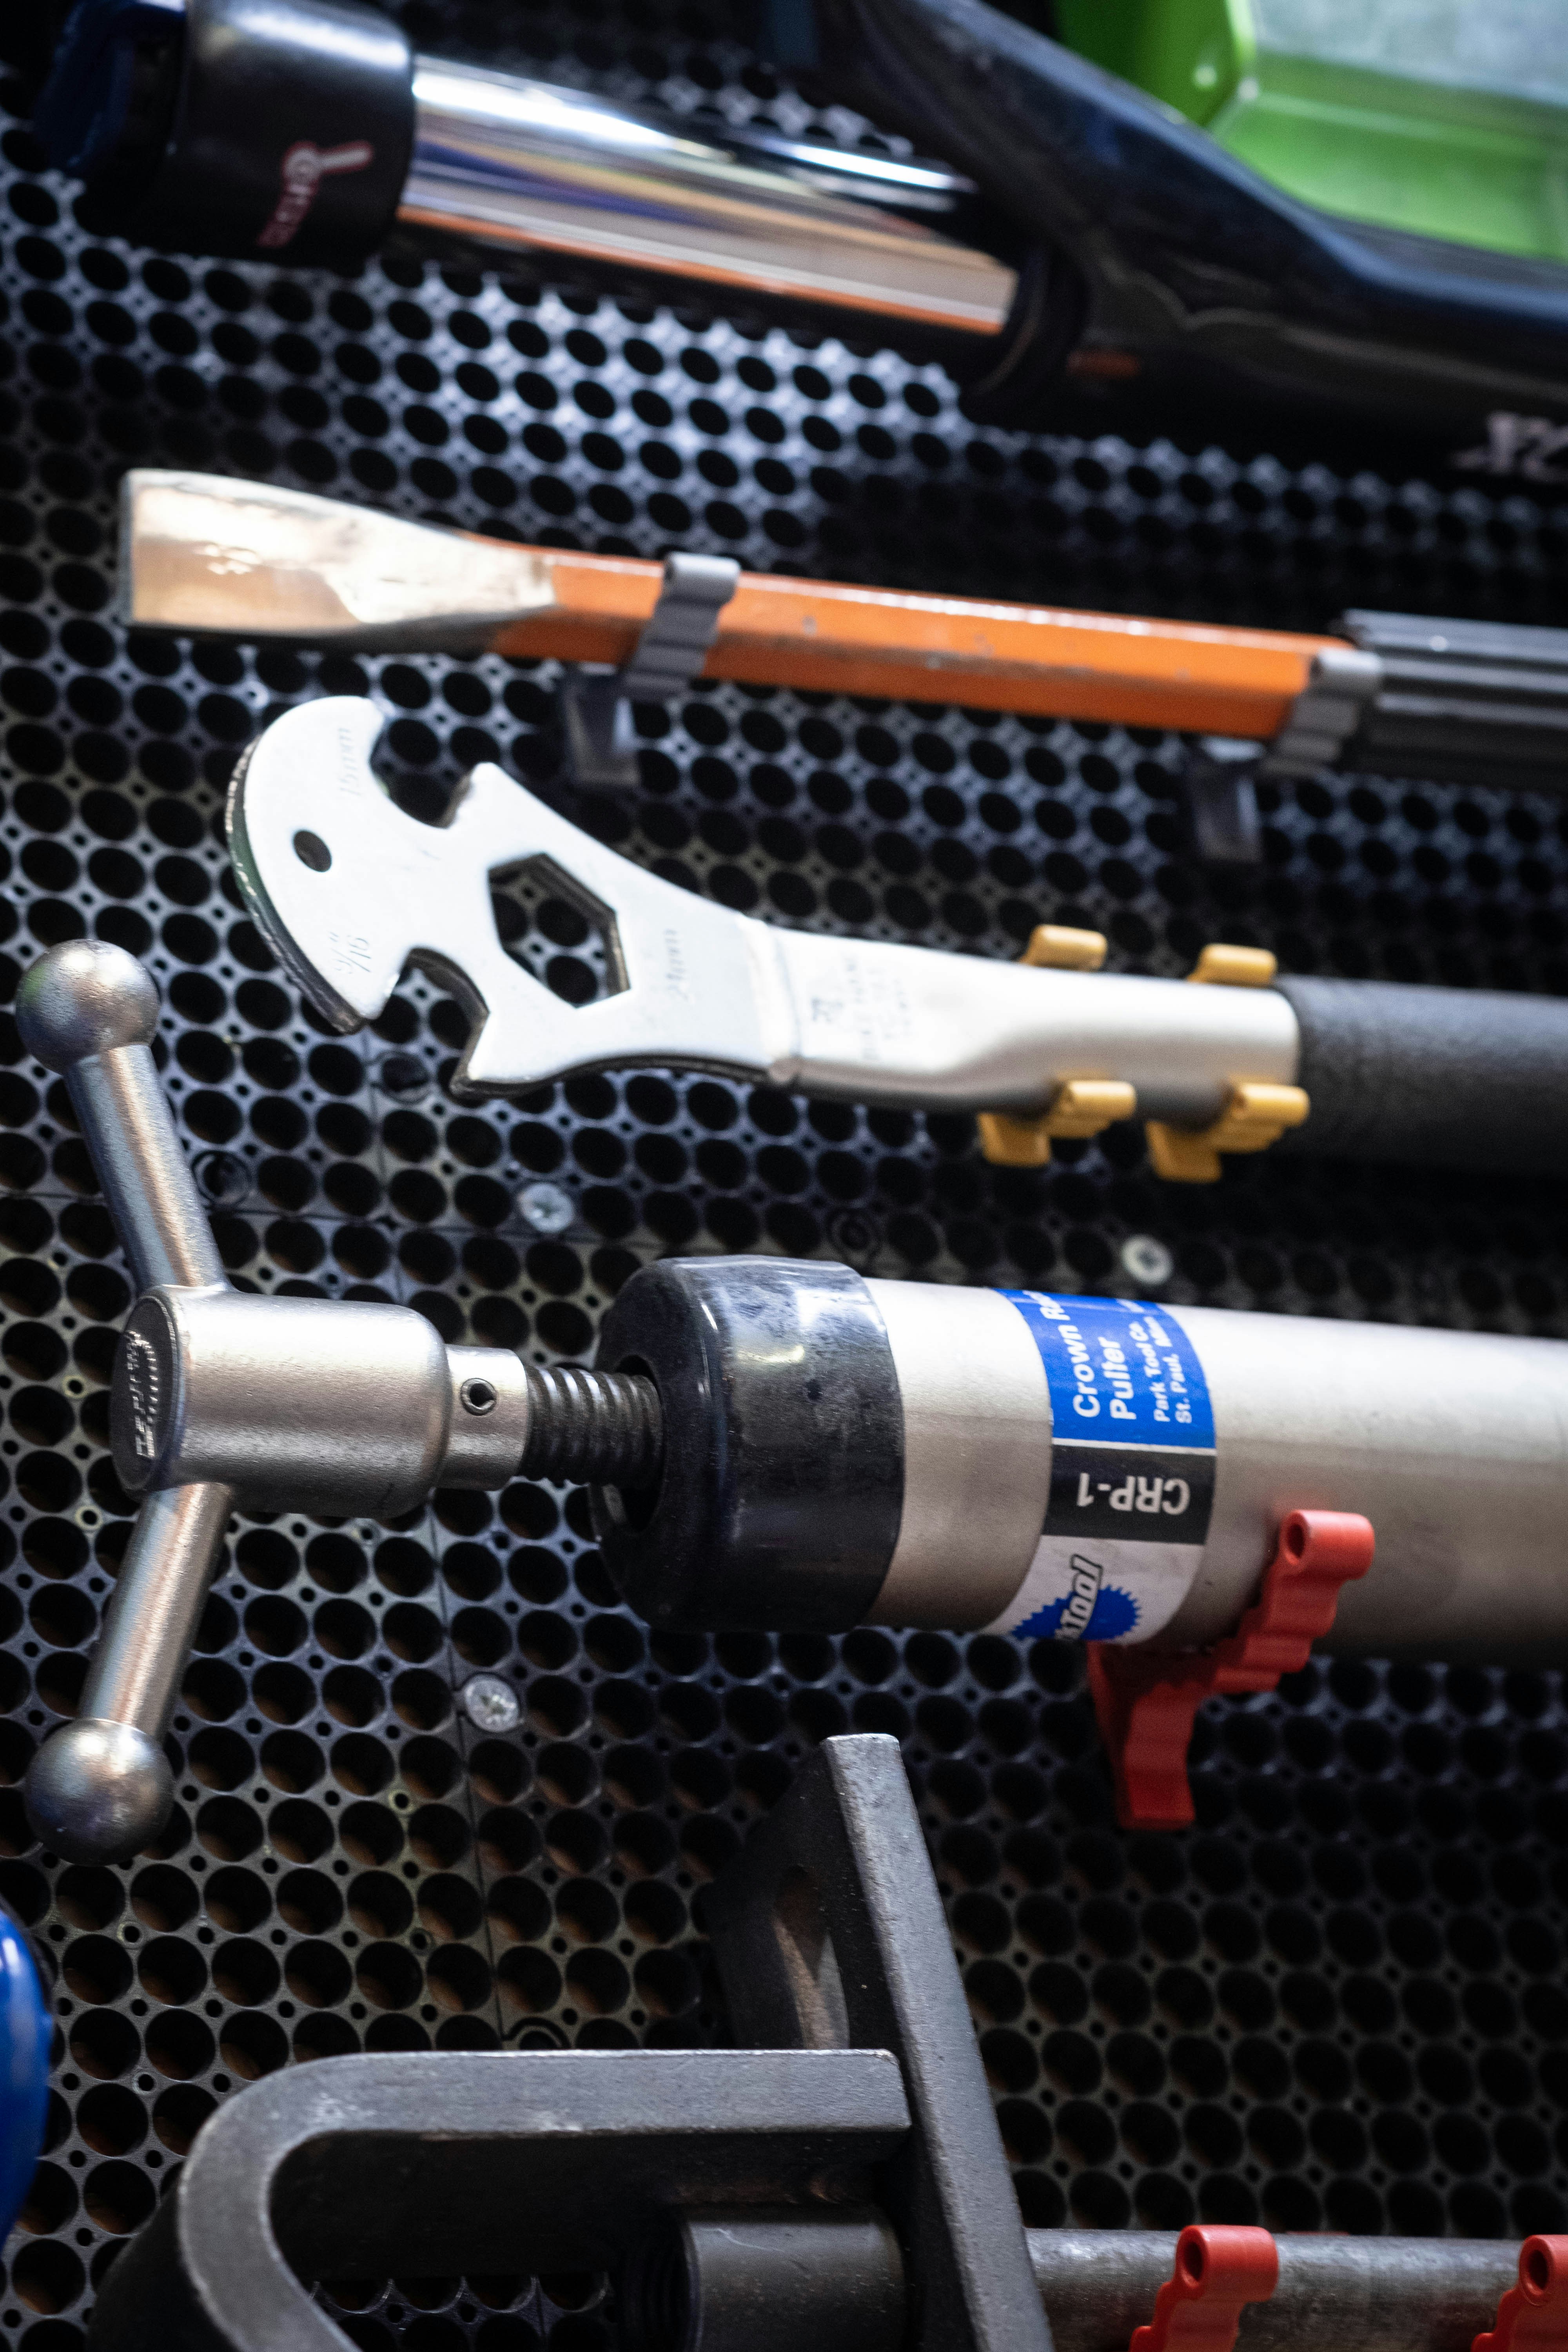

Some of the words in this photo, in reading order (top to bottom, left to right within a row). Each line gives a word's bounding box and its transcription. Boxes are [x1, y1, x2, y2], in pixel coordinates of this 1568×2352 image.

[1058, 1325, 1101, 1418] Crown
[1096, 1337, 1137, 1420] Puller
[1135, 1343, 1160, 1378] Tool
[1150, 1382, 1171, 1423] Park
[1173, 1398, 1193, 1424] St.
[1076, 1472, 1191, 1516] CRP-1
